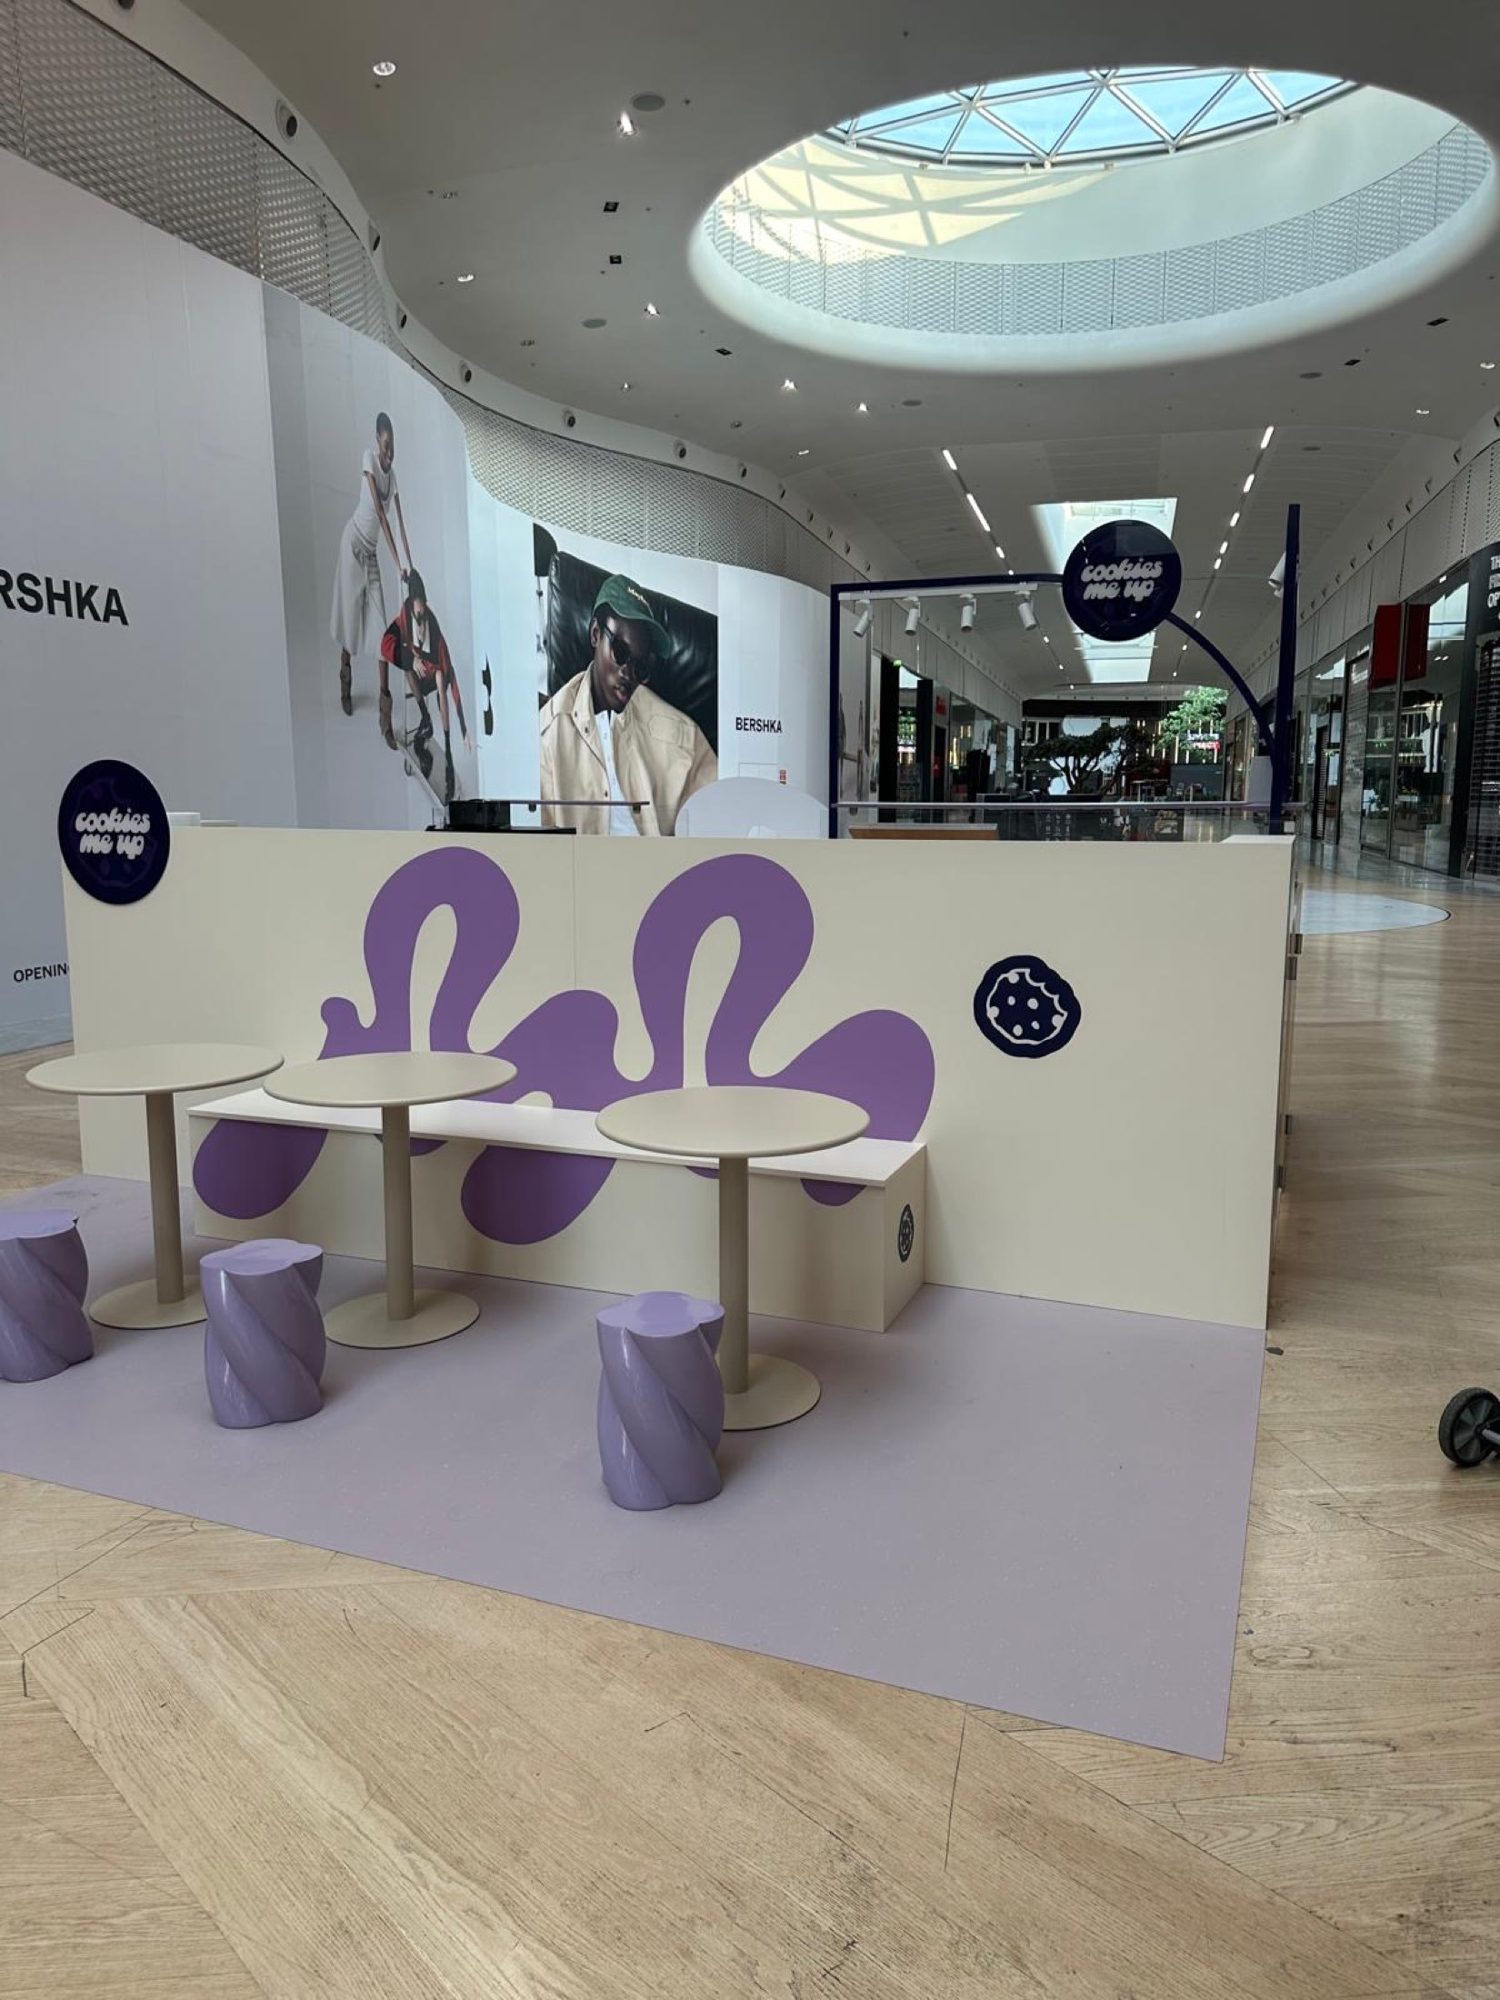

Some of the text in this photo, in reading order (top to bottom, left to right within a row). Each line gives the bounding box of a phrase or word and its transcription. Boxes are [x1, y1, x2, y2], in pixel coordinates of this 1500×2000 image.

[1081, 558, 1162, 582] cookies
[1083, 580, 1155, 601] me up
[735, 716, 783, 734] BERSHKA
[75, 807, 151, 834] cookies
[79, 834, 145, 860] me up
[13, 962, 70, 983] OPENIN
